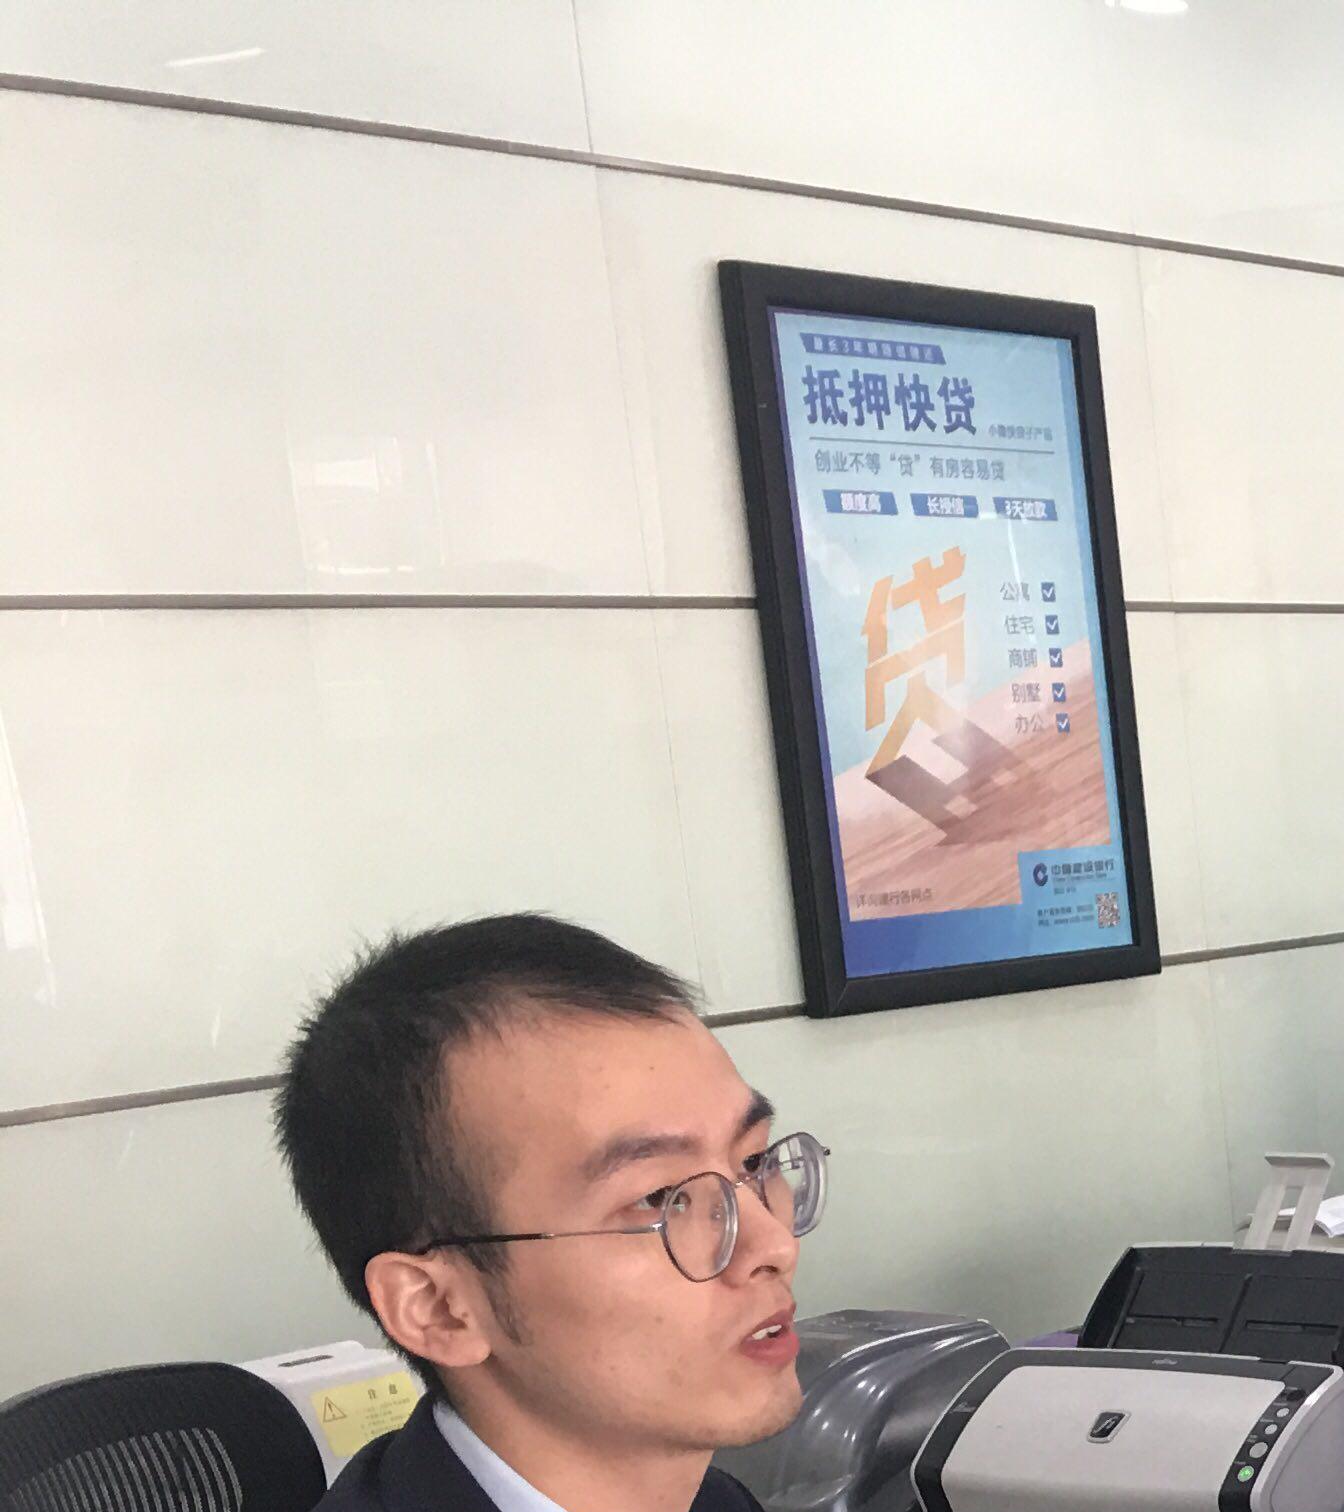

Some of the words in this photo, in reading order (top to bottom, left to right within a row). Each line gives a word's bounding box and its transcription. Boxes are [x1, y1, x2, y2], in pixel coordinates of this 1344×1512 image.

[802, 365, 977, 435] 抵押快贷
[1004, 615, 1035, 635] 住宅
[1008, 648, 1038, 668] 商铺
[1011, 682, 1041, 703] 别墅
[1015, 713, 1045, 734] 办公
